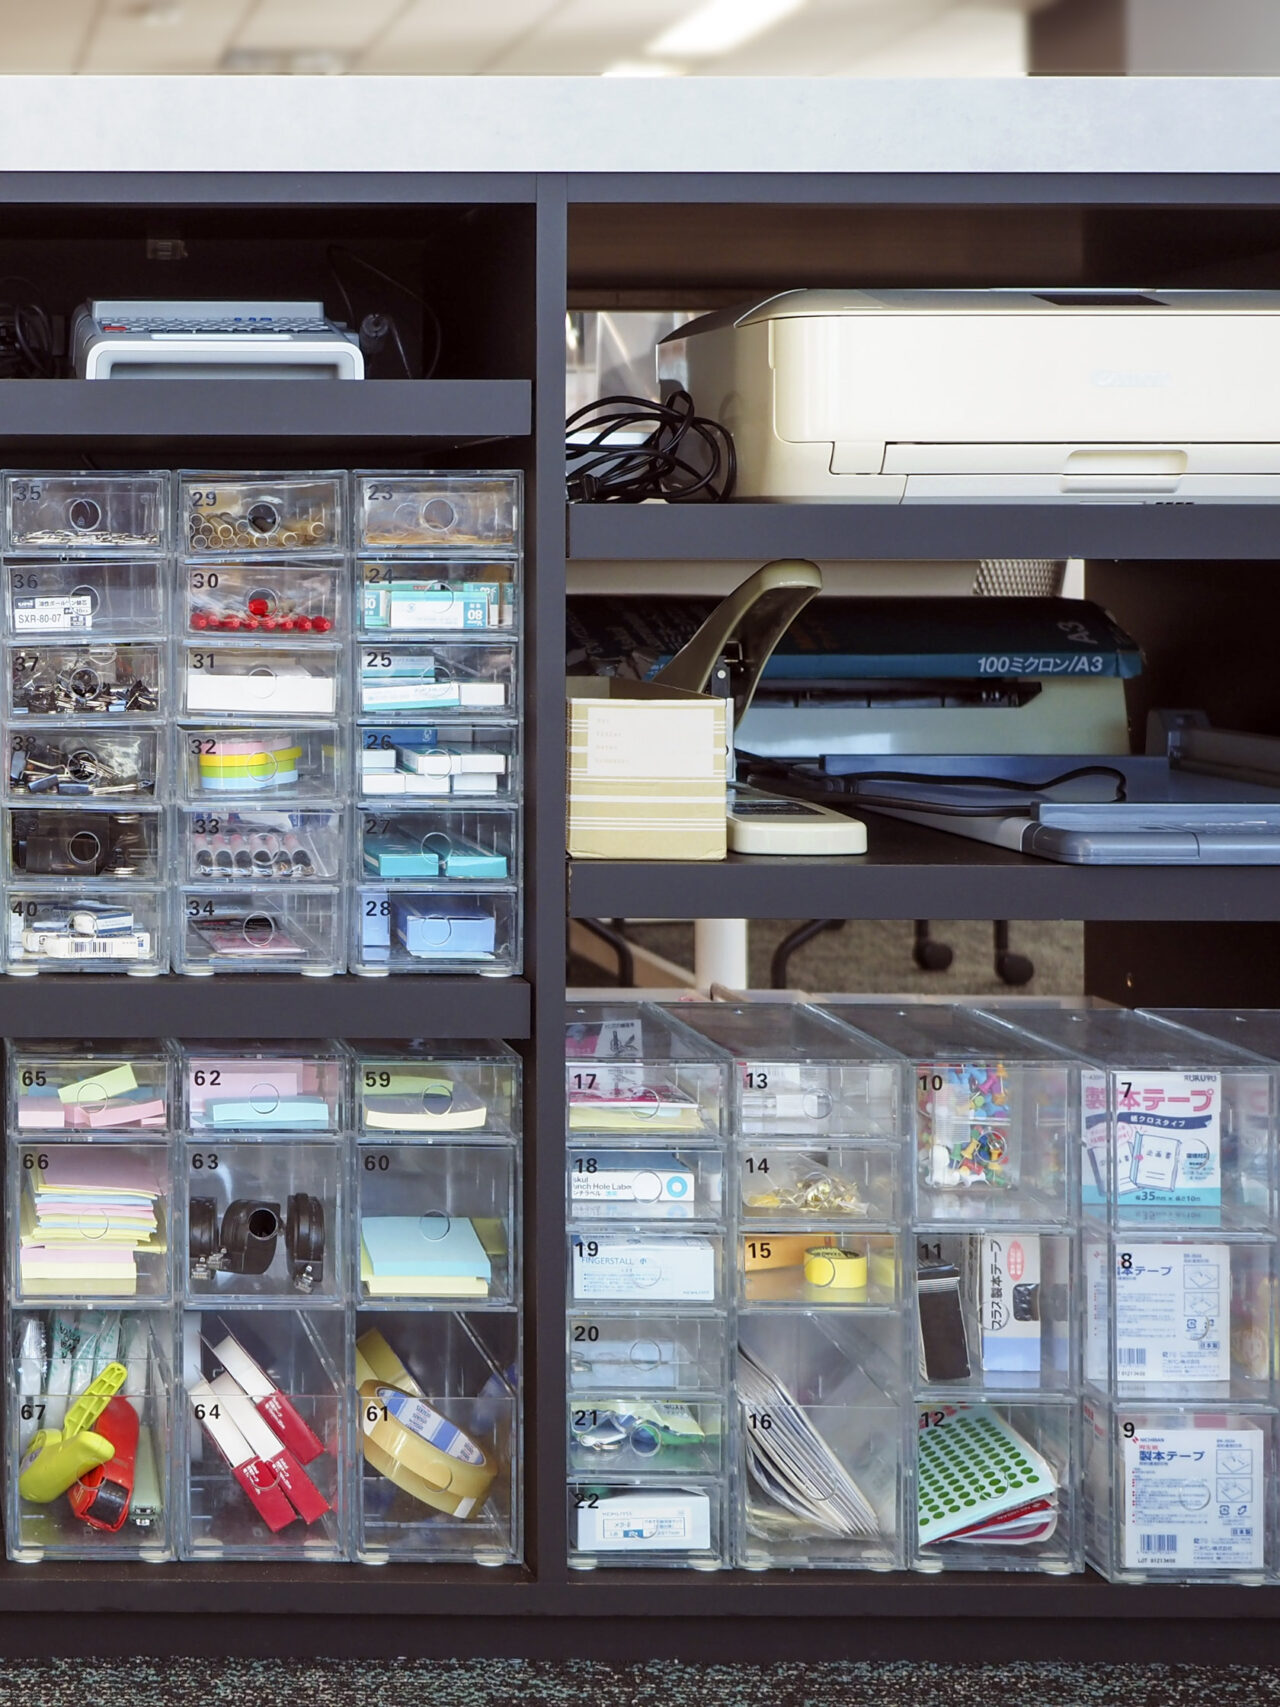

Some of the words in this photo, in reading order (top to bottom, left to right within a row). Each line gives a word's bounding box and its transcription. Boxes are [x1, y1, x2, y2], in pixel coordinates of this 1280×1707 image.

[16, 485, 41, 501] 35
[193, 491, 217, 508] 29
[368, 485, 393, 501] 23
[14, 574, 38, 589] 36
[193, 573, 218, 589] 30
[368, 568, 393, 584] 24
[18, 613, 62, 624] SXR-80-07
[467, 609, 484, 620] 80
[13, 656, 38, 672] 37
[193, 653, 216, 670] 31
[367, 652, 392, 667] 25
[977, 655, 1103, 673] 100ミクロン/A3
[13, 736, 37, 752] 38
[192, 739, 217, 755] 32
[368, 733, 392, 750] 26
[13, 818, 38, 835] 39
[195, 818, 220, 835] 33
[366, 818, 391, 835] 27
[12, 901, 37, 917] 40
[189, 900, 215, 917] 34
[366, 901, 391, 917] 28
[22, 1070, 47, 1087] 65
[194, 1070, 222, 1086] 62
[365, 1071, 392, 1088] 59
[574, 1073, 597, 1089] 17
[746, 1072, 768, 1089] 13
[919, 1075, 943, 1091] 10
[1121, 1082, 1132, 1098] 7
[1130, 1115, 1186, 1127] 紙クロスタイプ
[22, 1153, 49, 1170] 66
[192, 1153, 219, 1170] 63
[364, 1155, 391, 1171] 60
[575, 1158, 598, 1174] 18
[746, 1158, 769, 1174] 14
[575, 1241, 599, 1258] 19
[748, 1242, 772, 1259] 15
[921, 1243, 942, 1259] 11
[1121, 1253, 1132, 1269] 8
[574, 1325, 599, 1342] 20
[21, 1404, 46, 1421] 67
[194, 1404, 221, 1421] 64
[366, 1405, 388, 1422] 61
[574, 1410, 598, 1426] 21
[920, 1411, 945, 1427] 12
[749, 1413, 772, 1430] 16
[1123, 1422, 1135, 1438] 9
[1139, 1450, 1205, 1461] 製本テープ
[573, 1493, 600, 1509] 22
